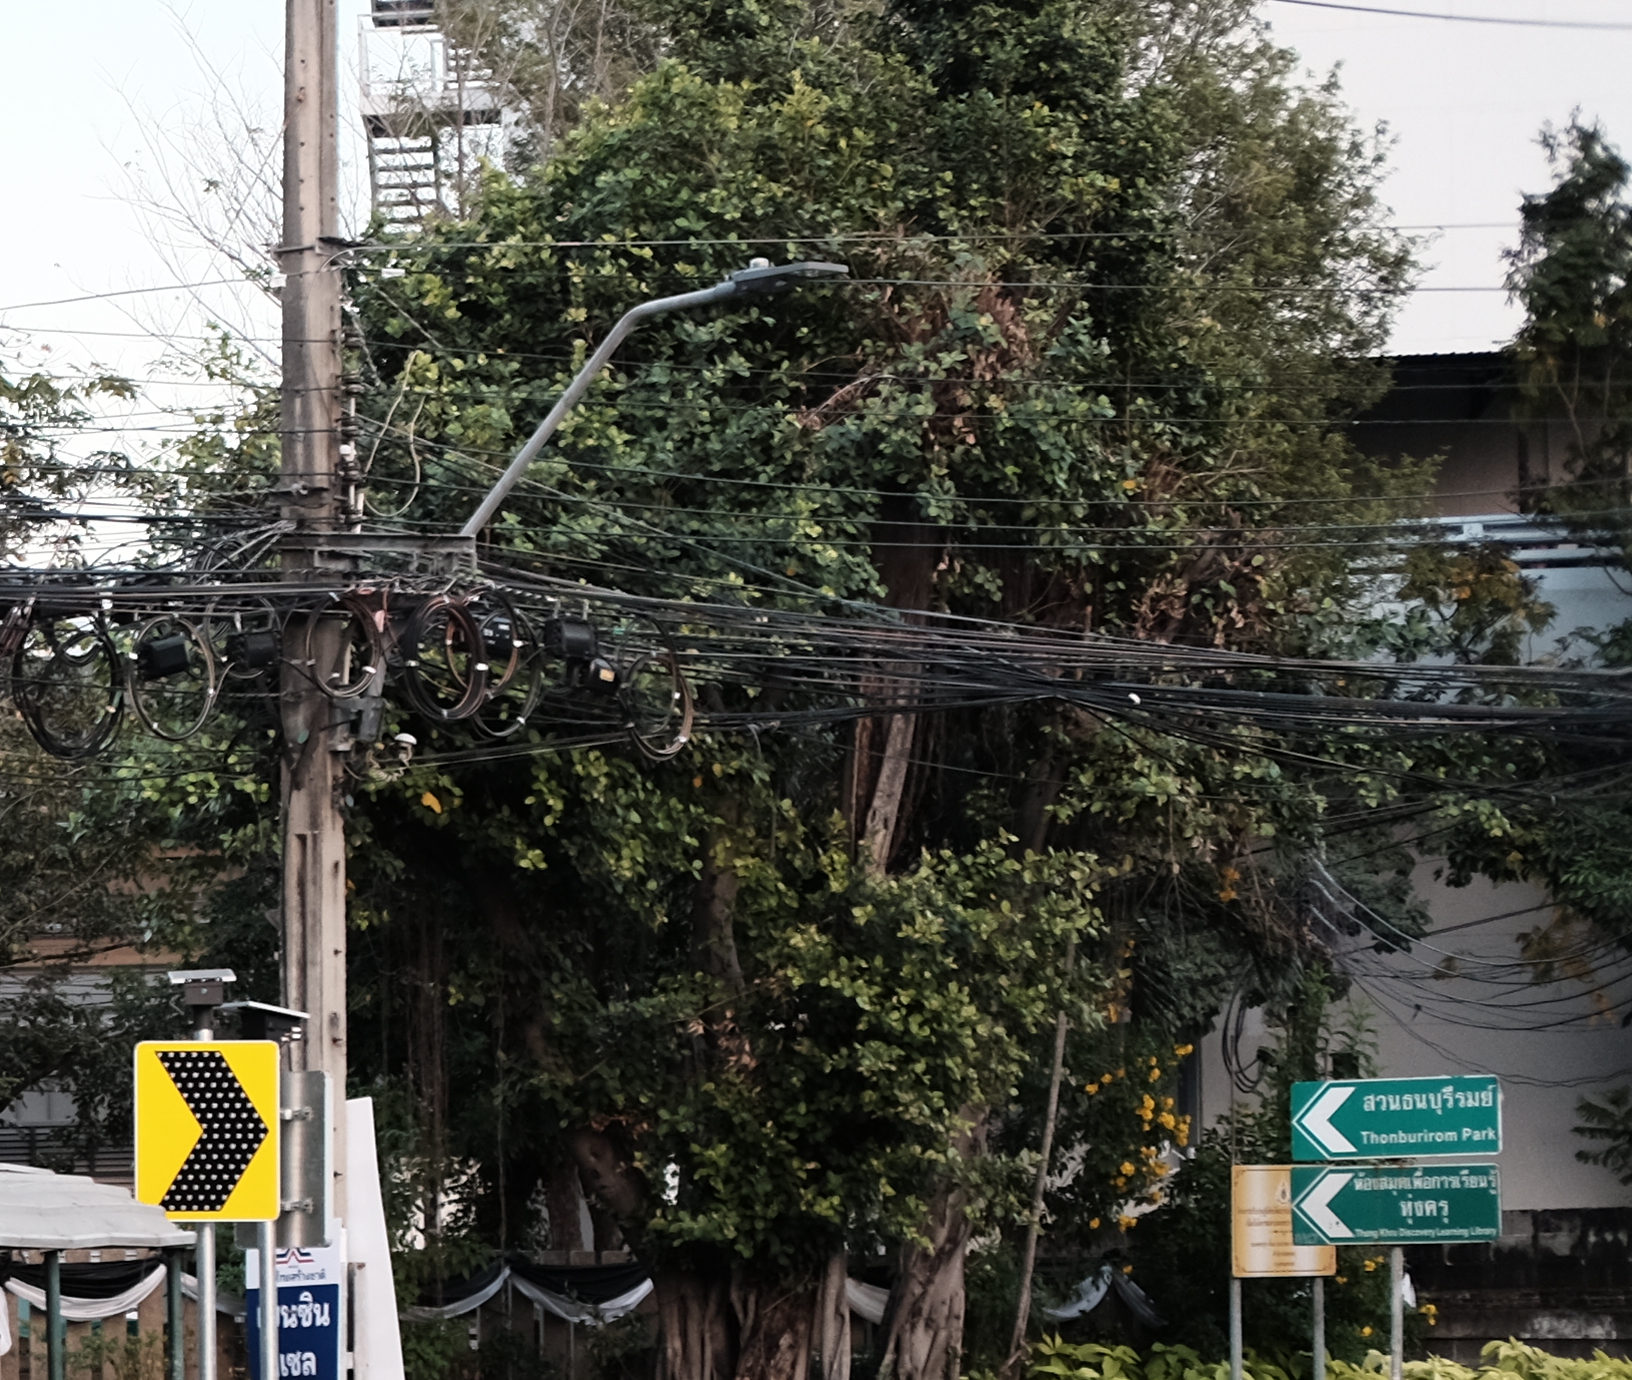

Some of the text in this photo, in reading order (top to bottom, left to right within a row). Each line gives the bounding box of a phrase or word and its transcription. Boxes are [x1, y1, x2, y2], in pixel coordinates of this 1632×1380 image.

[1362, 1085, 1497, 1116] สวนธนบุรีรมย์
[1361, 1127, 1497, 1145] Thonburirom Park
[257, 1291, 331, 1329] นซิน
